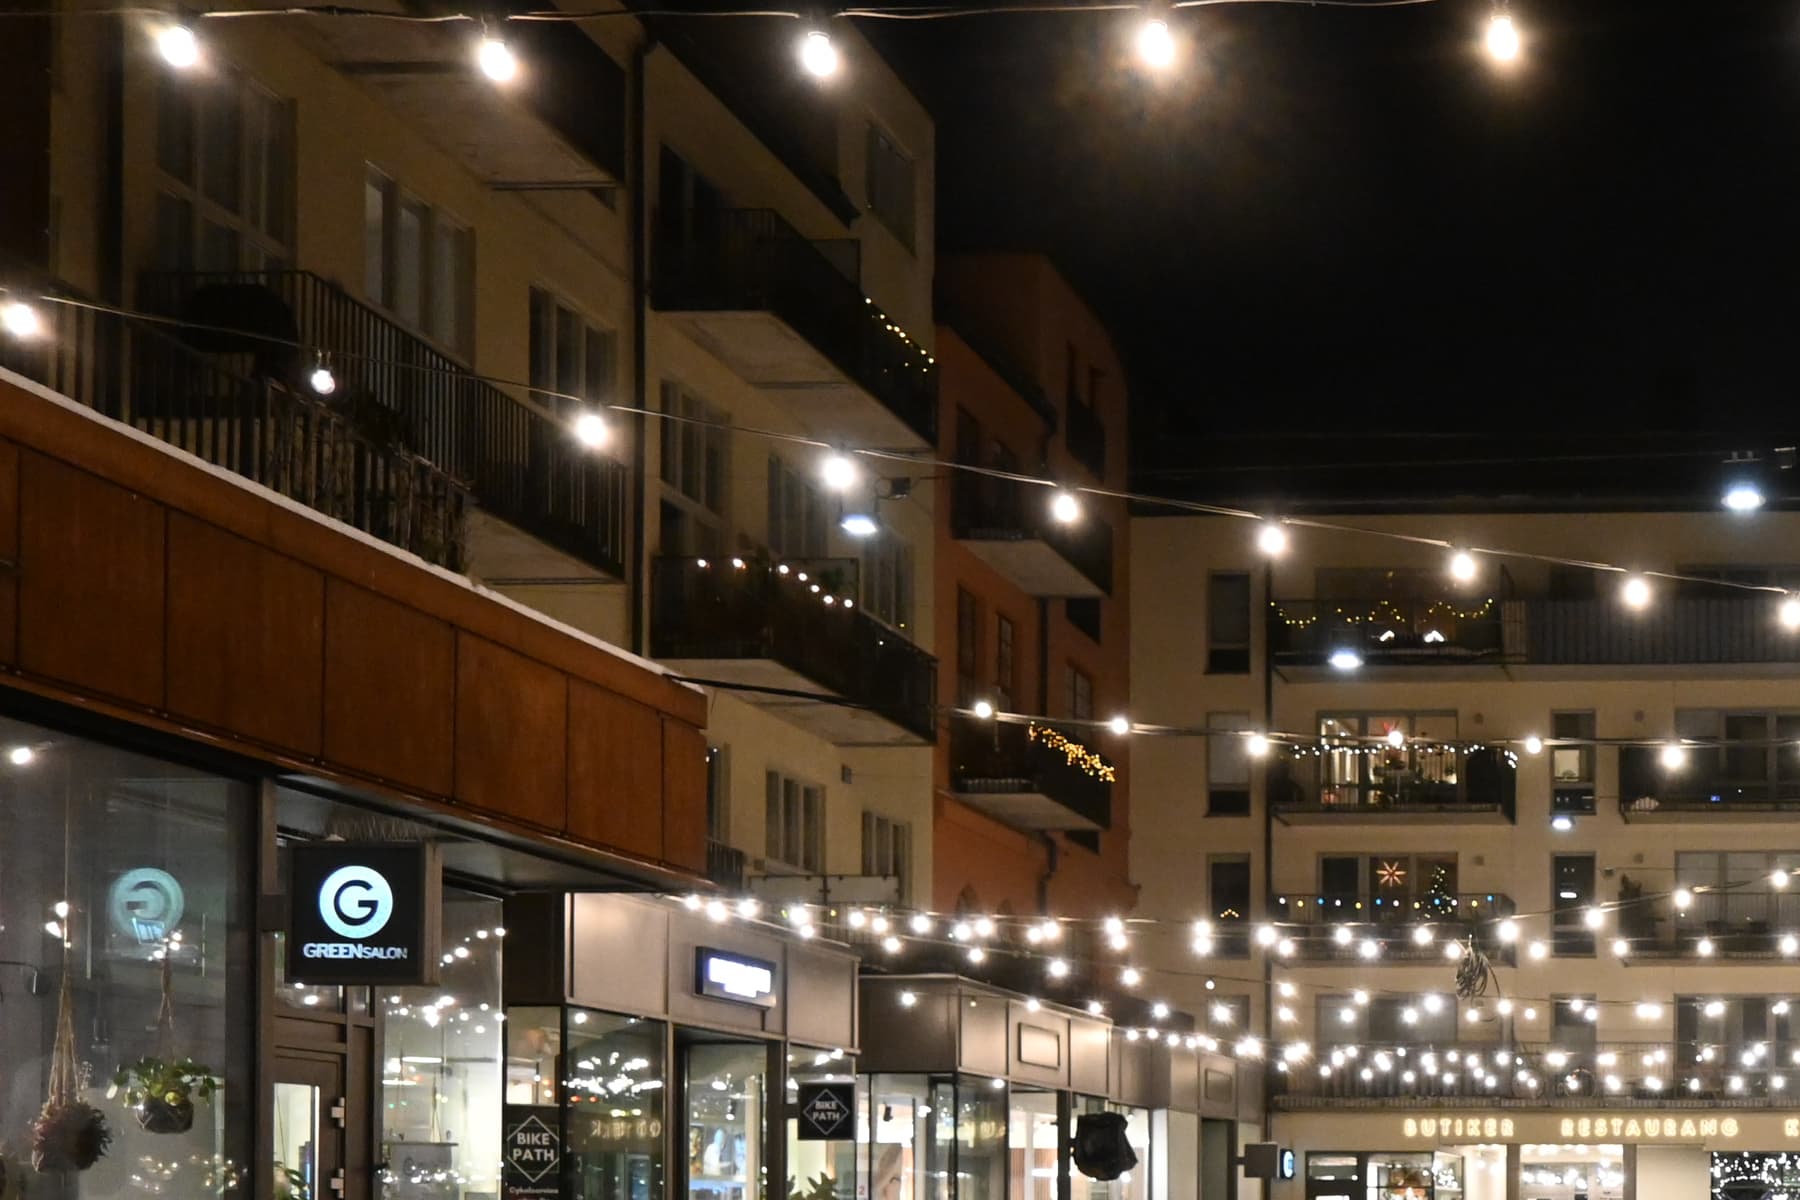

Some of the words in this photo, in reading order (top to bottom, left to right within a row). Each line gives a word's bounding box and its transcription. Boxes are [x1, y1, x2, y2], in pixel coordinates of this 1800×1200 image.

[334, 879, 379, 926] G
[815, 1101, 837, 1110] BIKE
[812, 1112, 840, 1121] PATH
[1403, 1118, 1514, 1137] BUTIKER
[1561, 1118, 1739, 1137] RESTAURANG
[516, 1132, 550, 1145] BIKE
[512, 1148, 555, 1161] PATH
